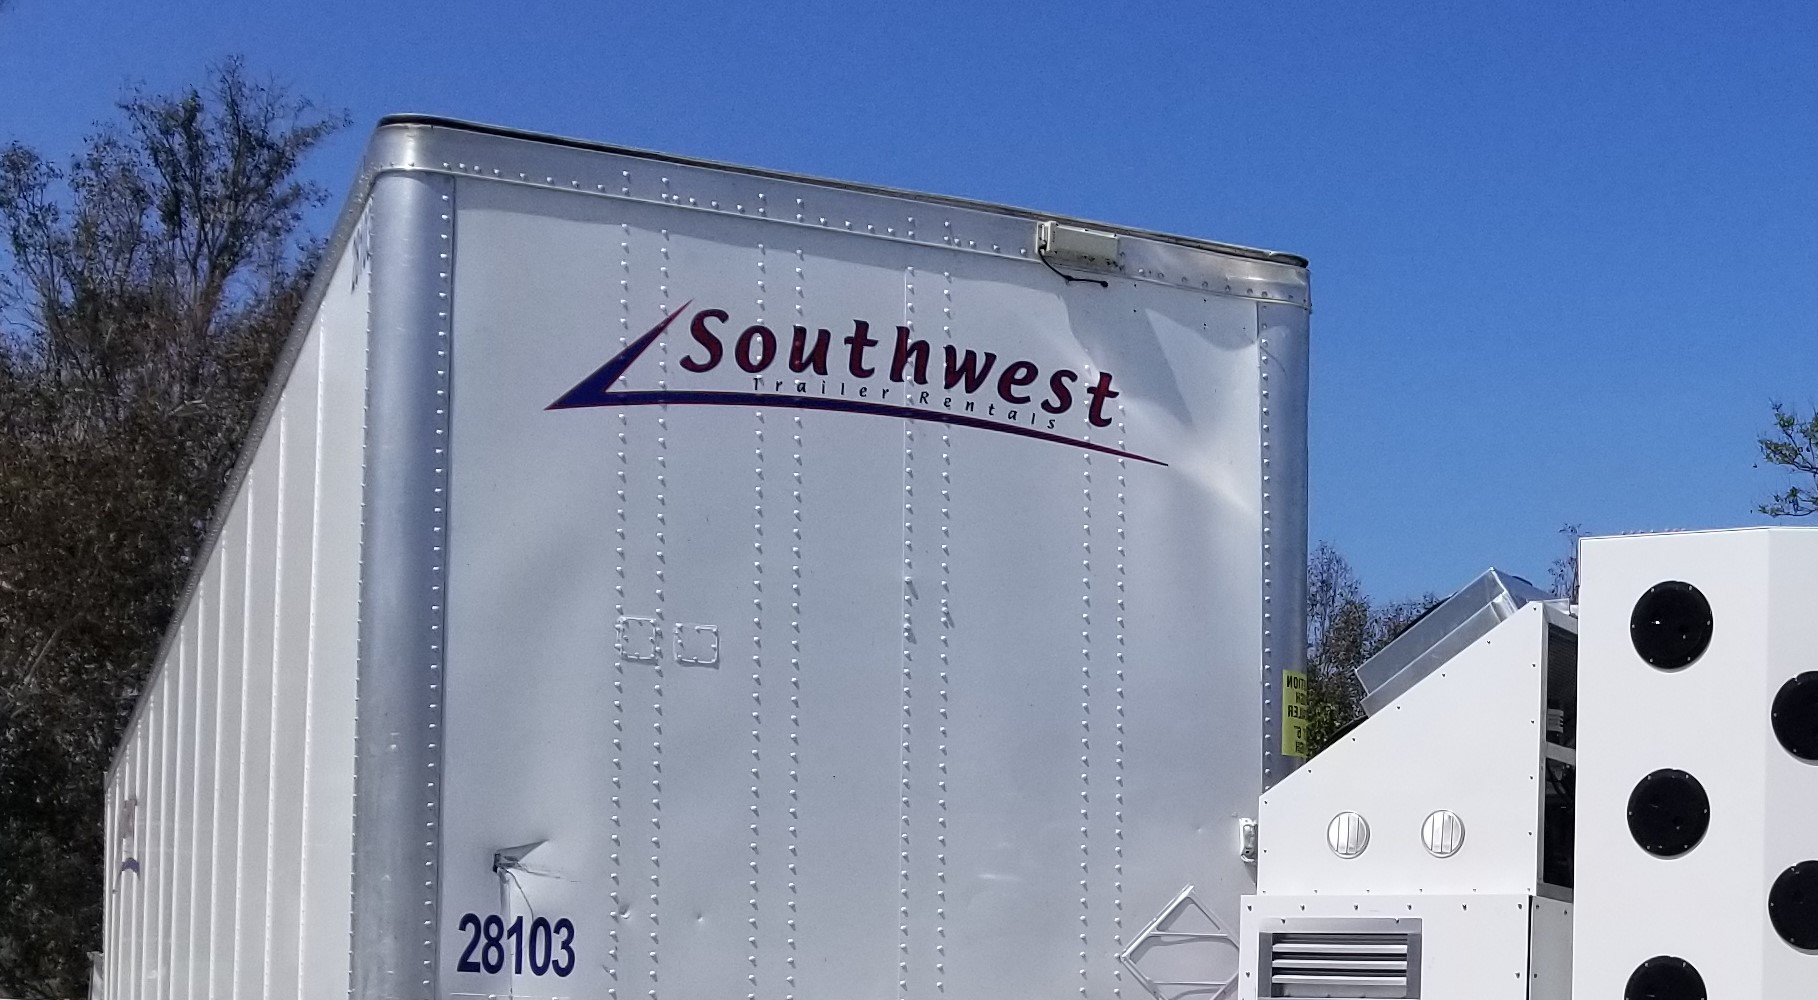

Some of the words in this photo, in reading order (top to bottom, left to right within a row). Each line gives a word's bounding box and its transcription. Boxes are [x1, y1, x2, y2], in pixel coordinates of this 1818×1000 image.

[679, 309, 1119, 428] Southwest
[753, 377, 890, 399] Trailer
[919, 391, 1056, 429] Rentals
[457, 913, 576, 977] 28103
